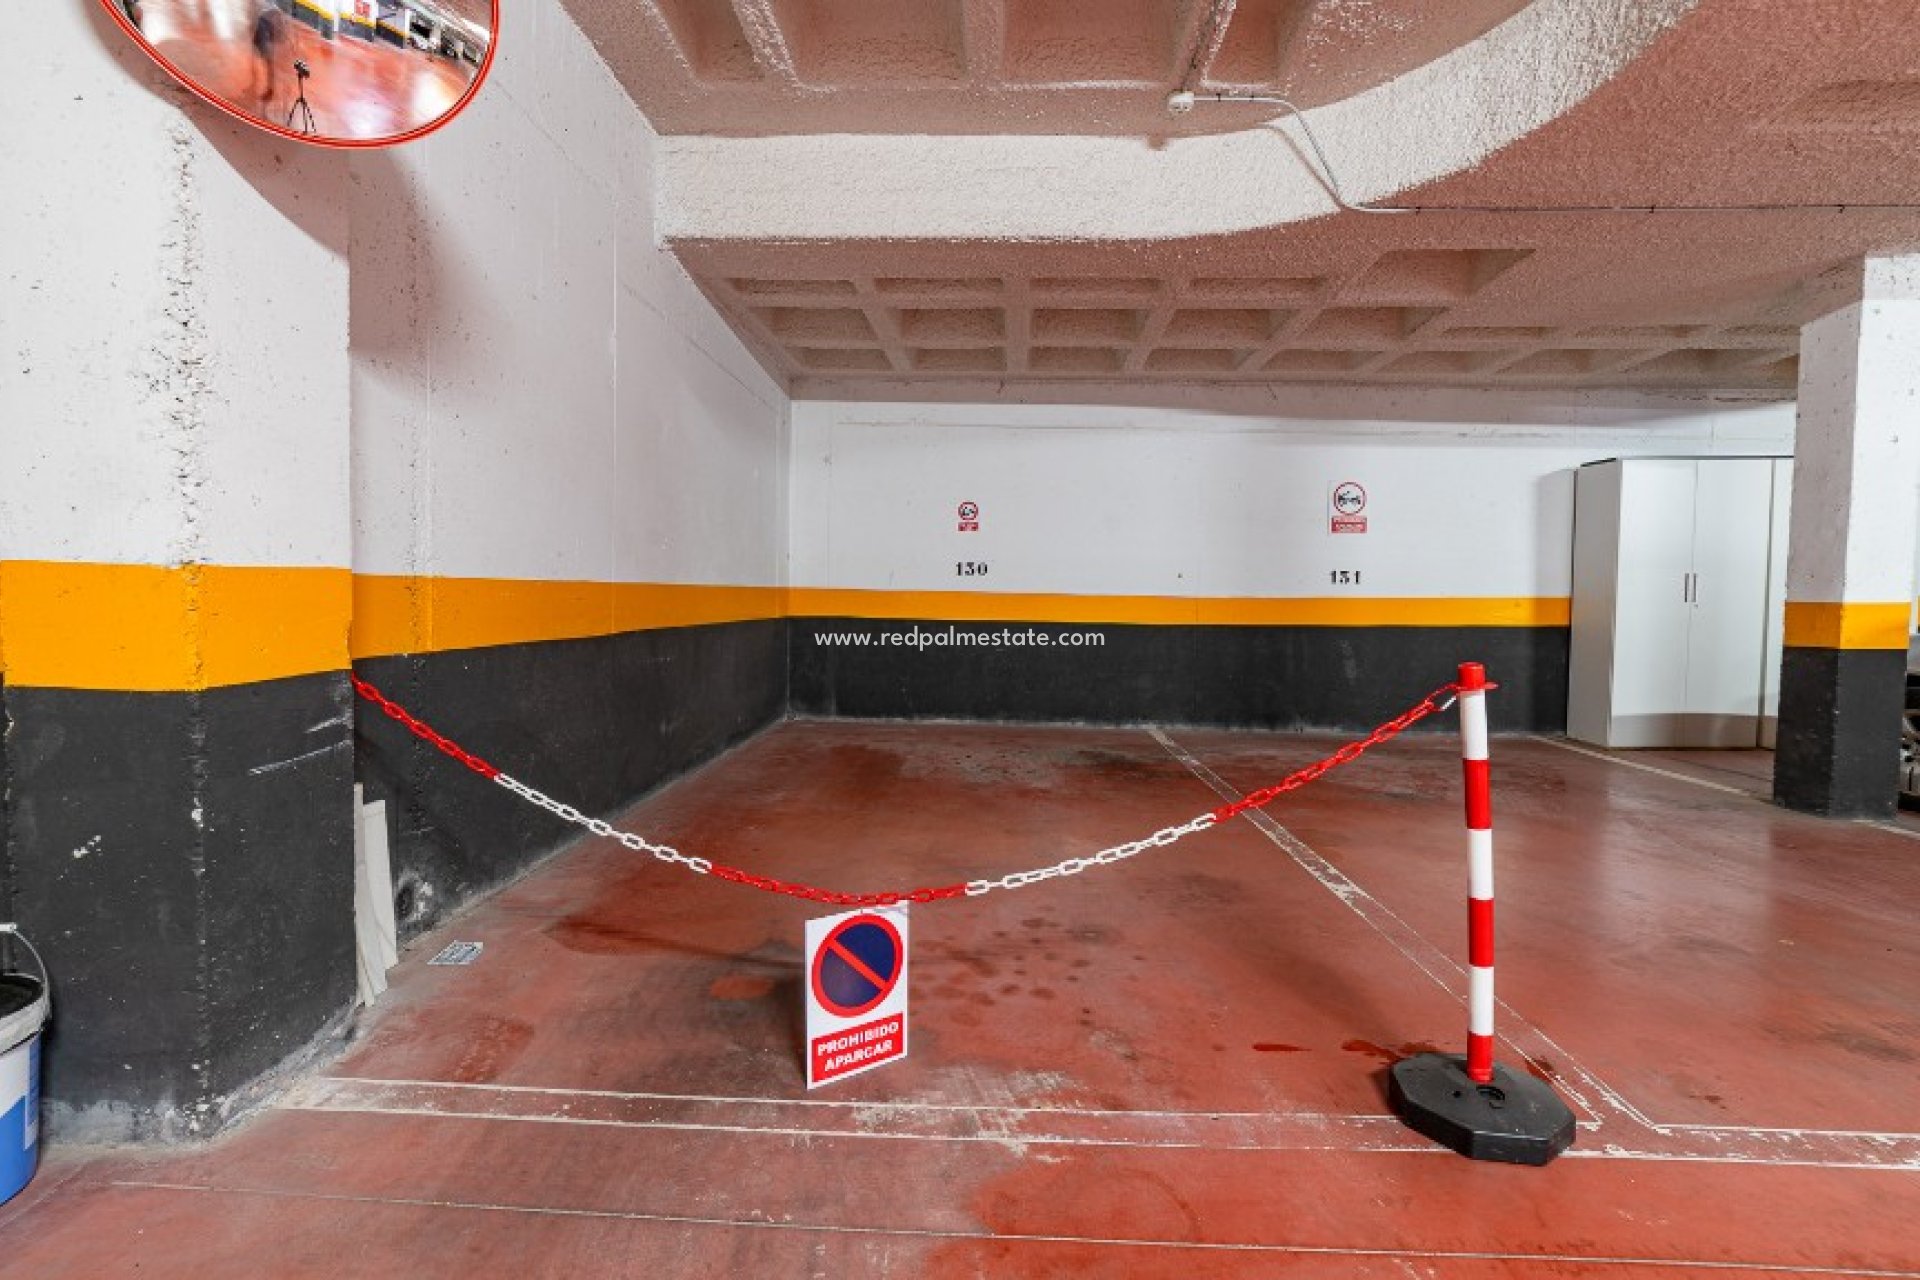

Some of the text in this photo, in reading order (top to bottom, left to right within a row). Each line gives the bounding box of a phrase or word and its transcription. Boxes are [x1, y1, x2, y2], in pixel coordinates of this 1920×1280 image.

[956, 562, 988, 576] 130
[1331, 570, 1361, 585] 131
[817, 1021, 899, 1056] PROHIBIDO
[824, 1038, 893, 1072] APARCAR
